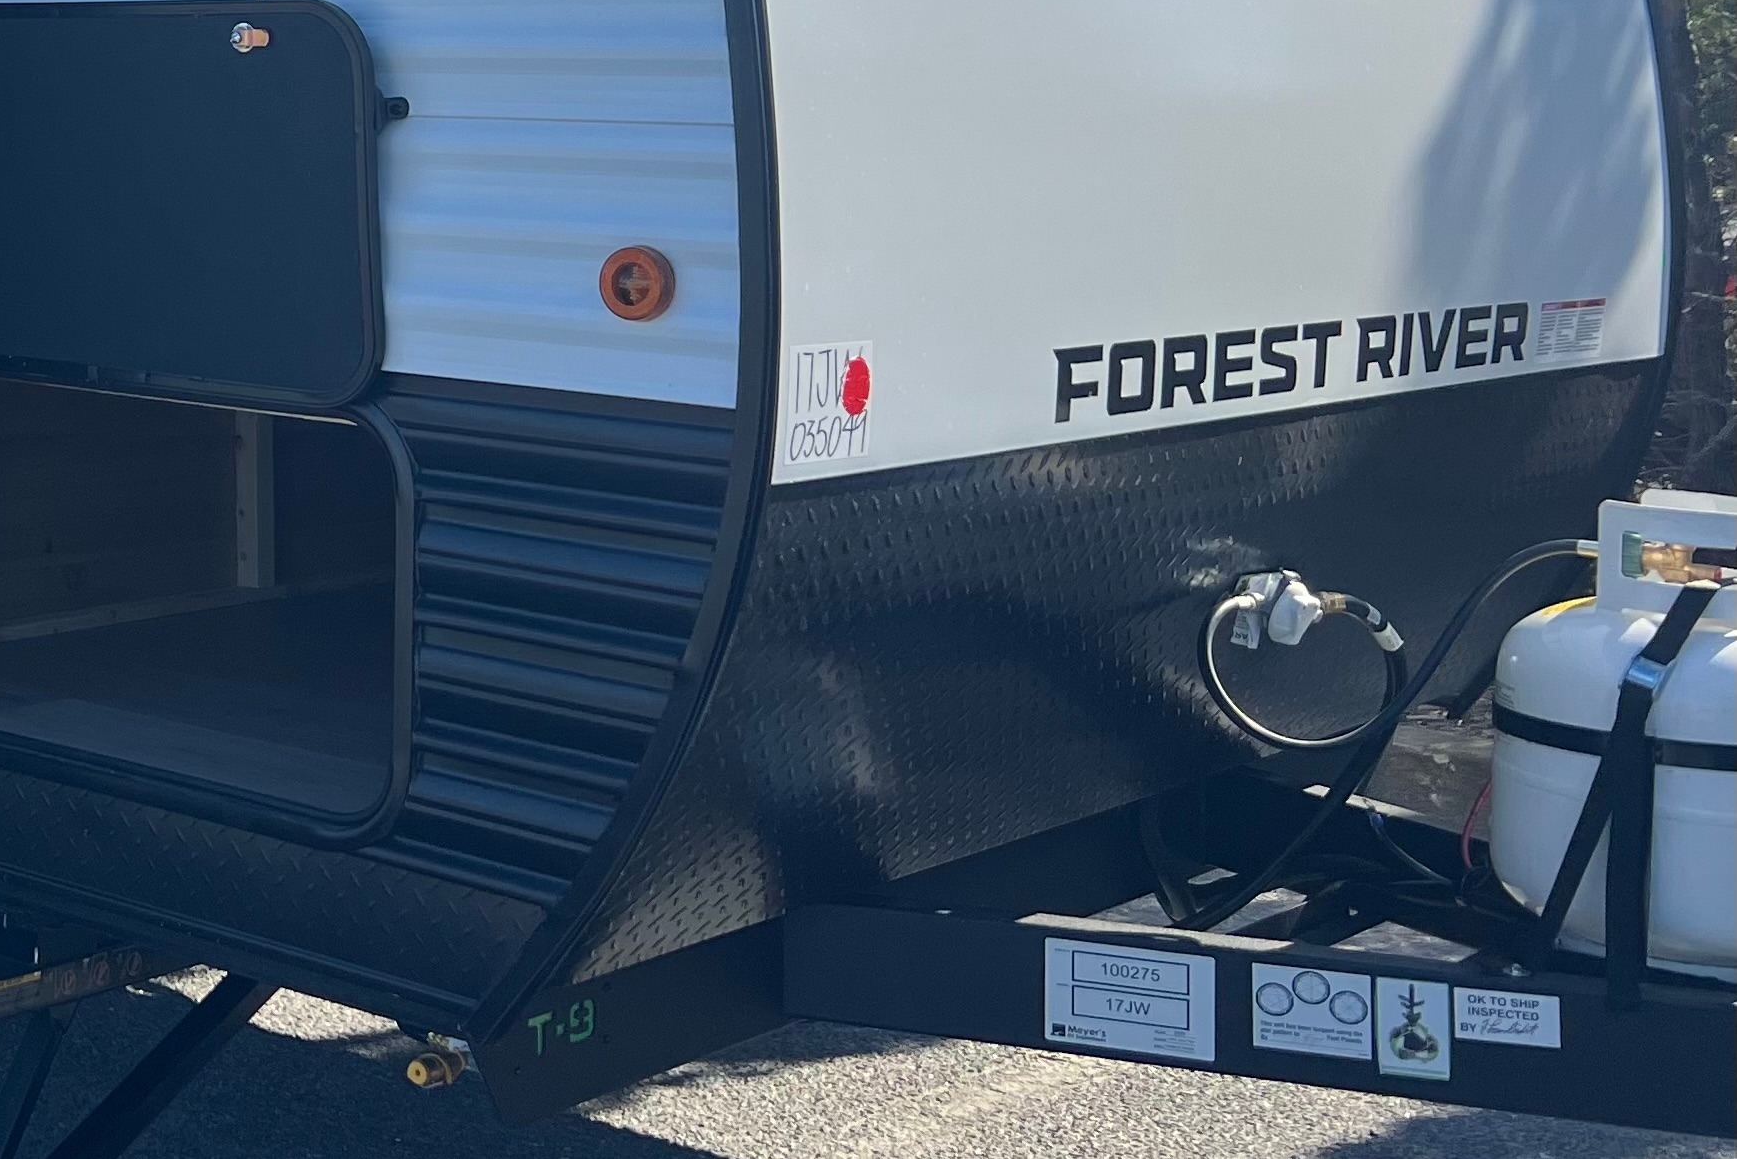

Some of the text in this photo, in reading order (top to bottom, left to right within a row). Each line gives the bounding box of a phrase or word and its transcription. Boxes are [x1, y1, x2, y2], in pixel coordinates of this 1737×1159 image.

[1052, 319, 1343, 425] FOREST
[1356, 301, 1529, 383] RIVER
[1100, 961, 1161, 983] 100275
[1105, 998, 1151, 1016] 17JW
[1467, 994, 1540, 1010] OK TO SHIP
[1467, 1006, 1540, 1022] INSPECTED
[1460, 1022, 1477, 1033] BY
